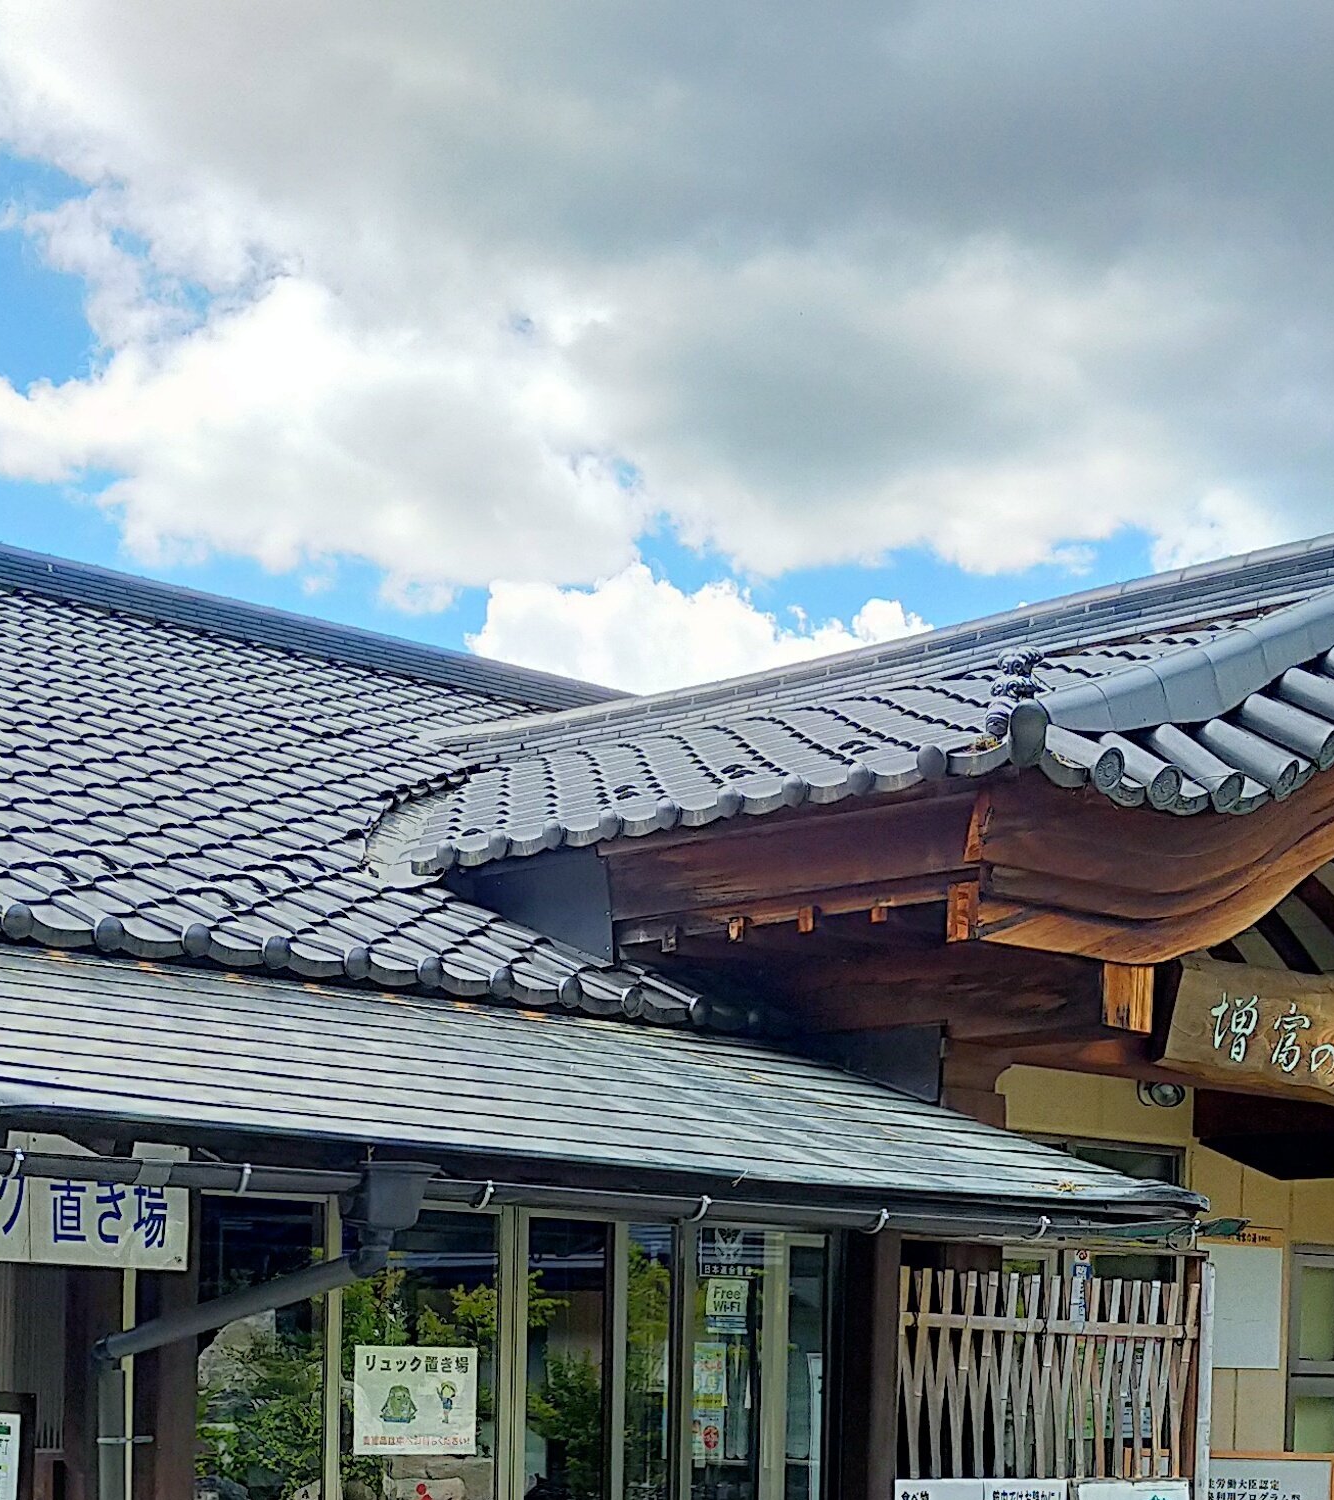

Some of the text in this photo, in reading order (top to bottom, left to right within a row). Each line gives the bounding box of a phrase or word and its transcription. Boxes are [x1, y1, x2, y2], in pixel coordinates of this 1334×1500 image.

[713, 1286, 741, 1299] Free
[365, 1354, 469, 1374] リュック置き場
